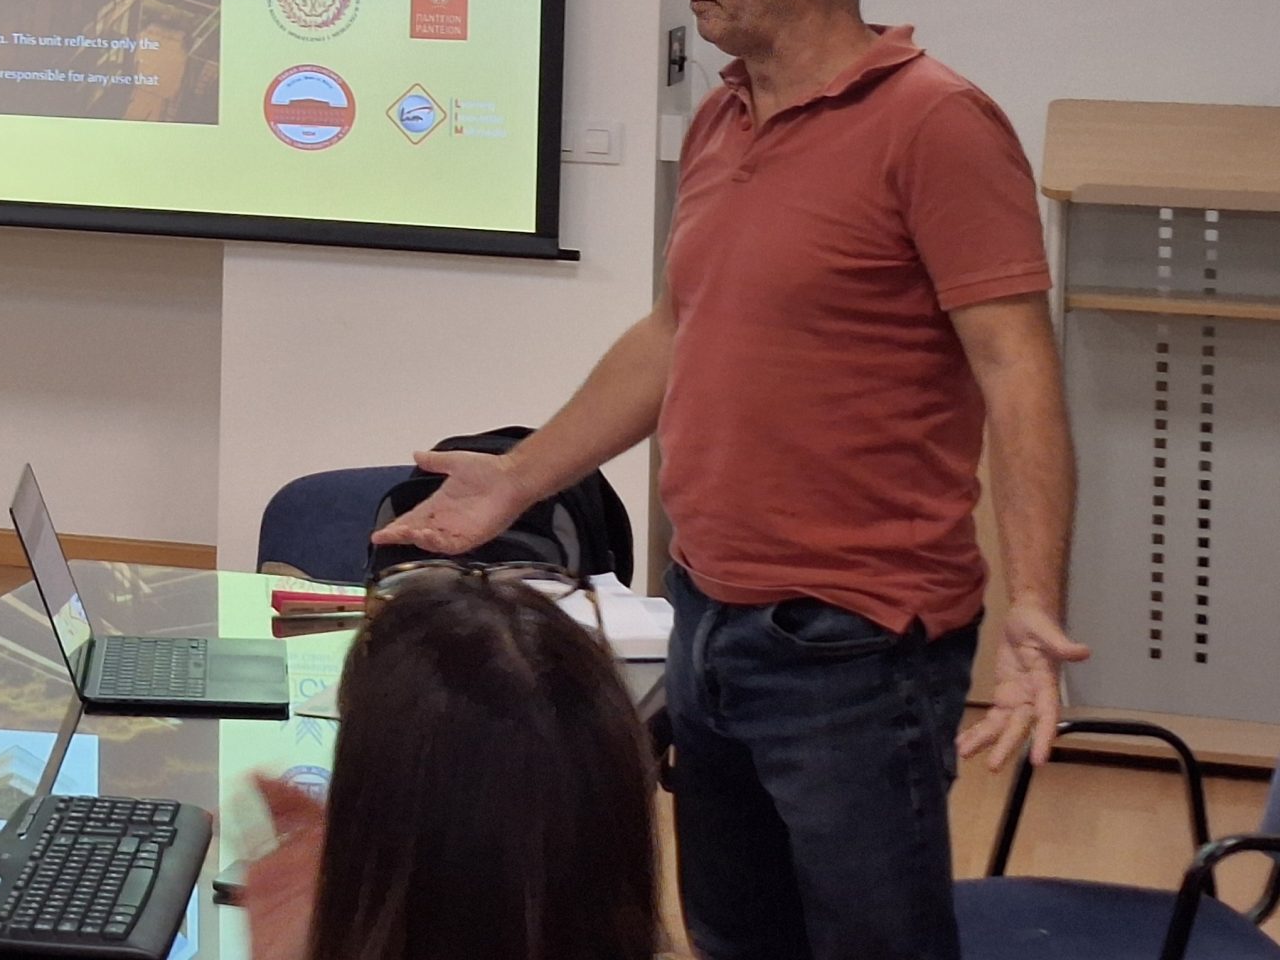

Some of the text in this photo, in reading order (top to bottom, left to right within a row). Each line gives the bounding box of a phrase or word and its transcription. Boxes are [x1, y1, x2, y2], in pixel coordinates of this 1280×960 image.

[12, 33, 37, 46] This
[39, 35, 62, 47] unit
[64, 35, 108, 48] reflects
[111, 37, 136, 52] only
[139, 37, 160, 50] the
[0, 69, 65, 83] responsible
[68, 70, 84, 82] for
[87, 73, 108, 87] any
[111, 74, 132, 85] use
[134, 72, 159, 85] that
